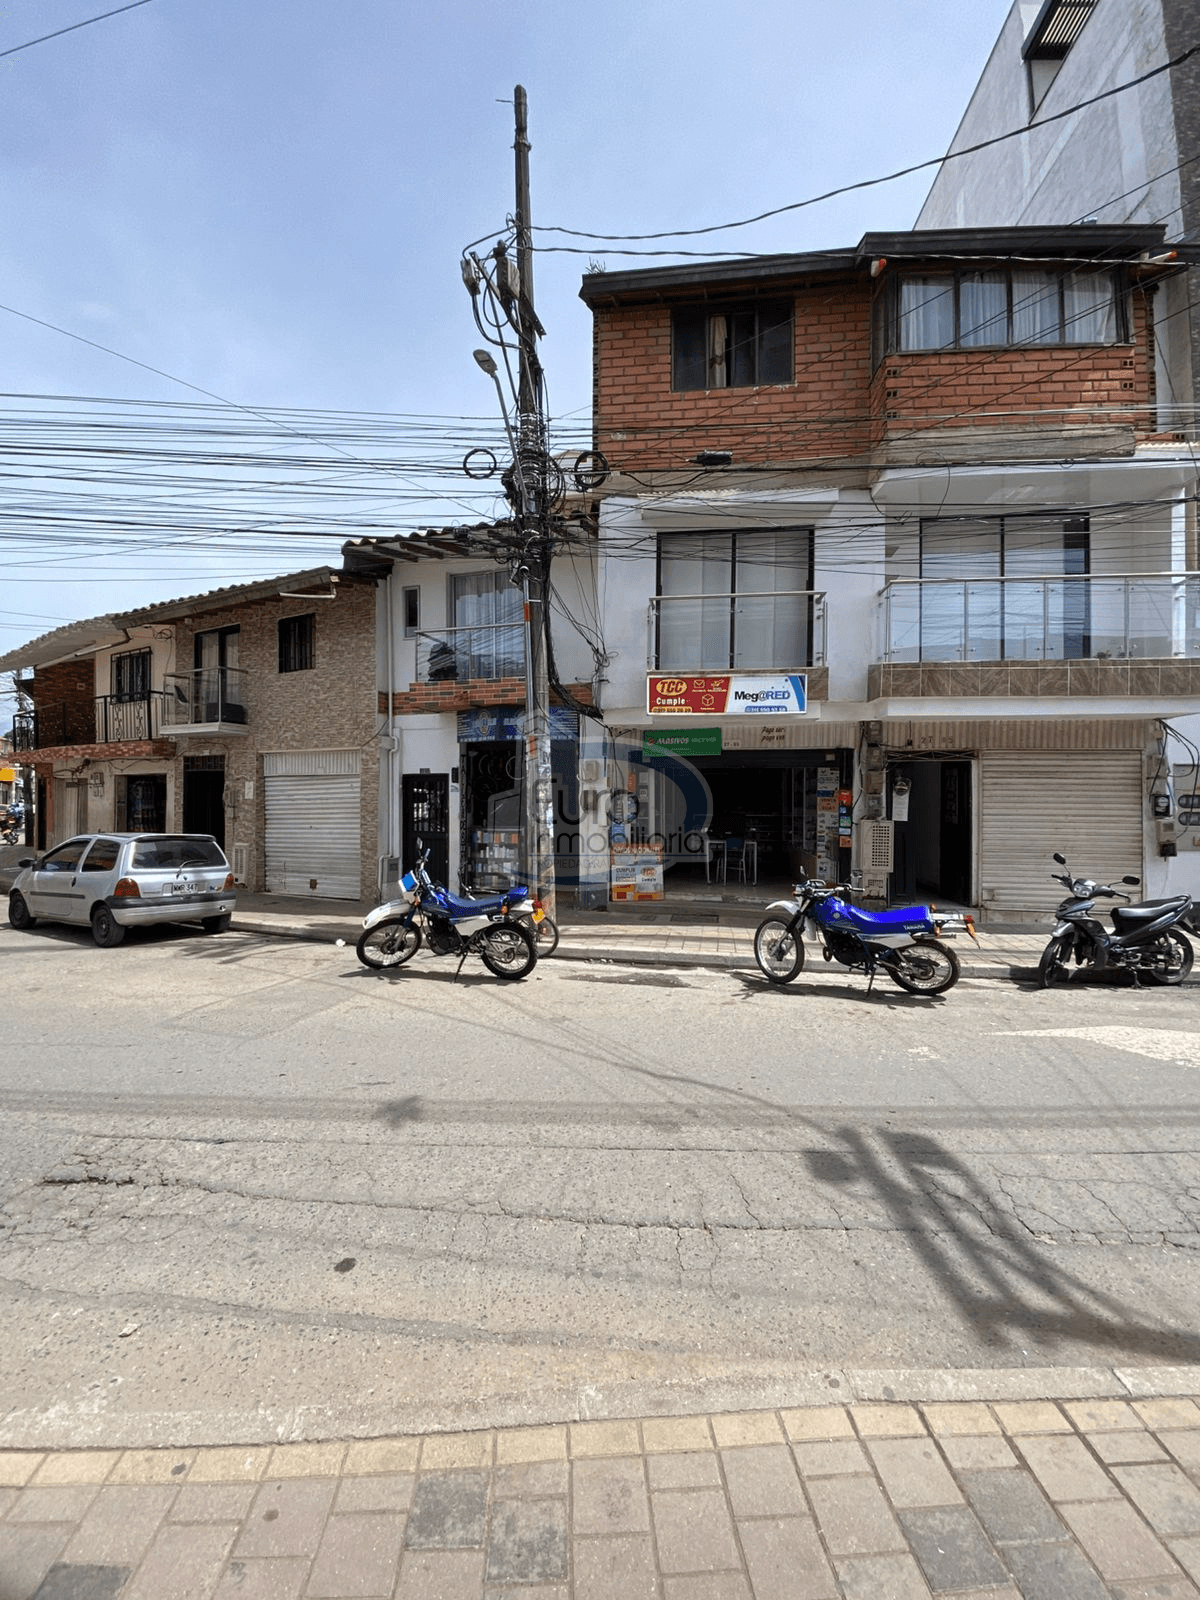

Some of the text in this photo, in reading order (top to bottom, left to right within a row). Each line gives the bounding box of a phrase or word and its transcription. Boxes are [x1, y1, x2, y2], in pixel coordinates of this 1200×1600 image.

[659, 681, 684, 694] TCC
[656, 697, 686, 706] Cumple
[734, 690, 791, 702] Meg@RED
